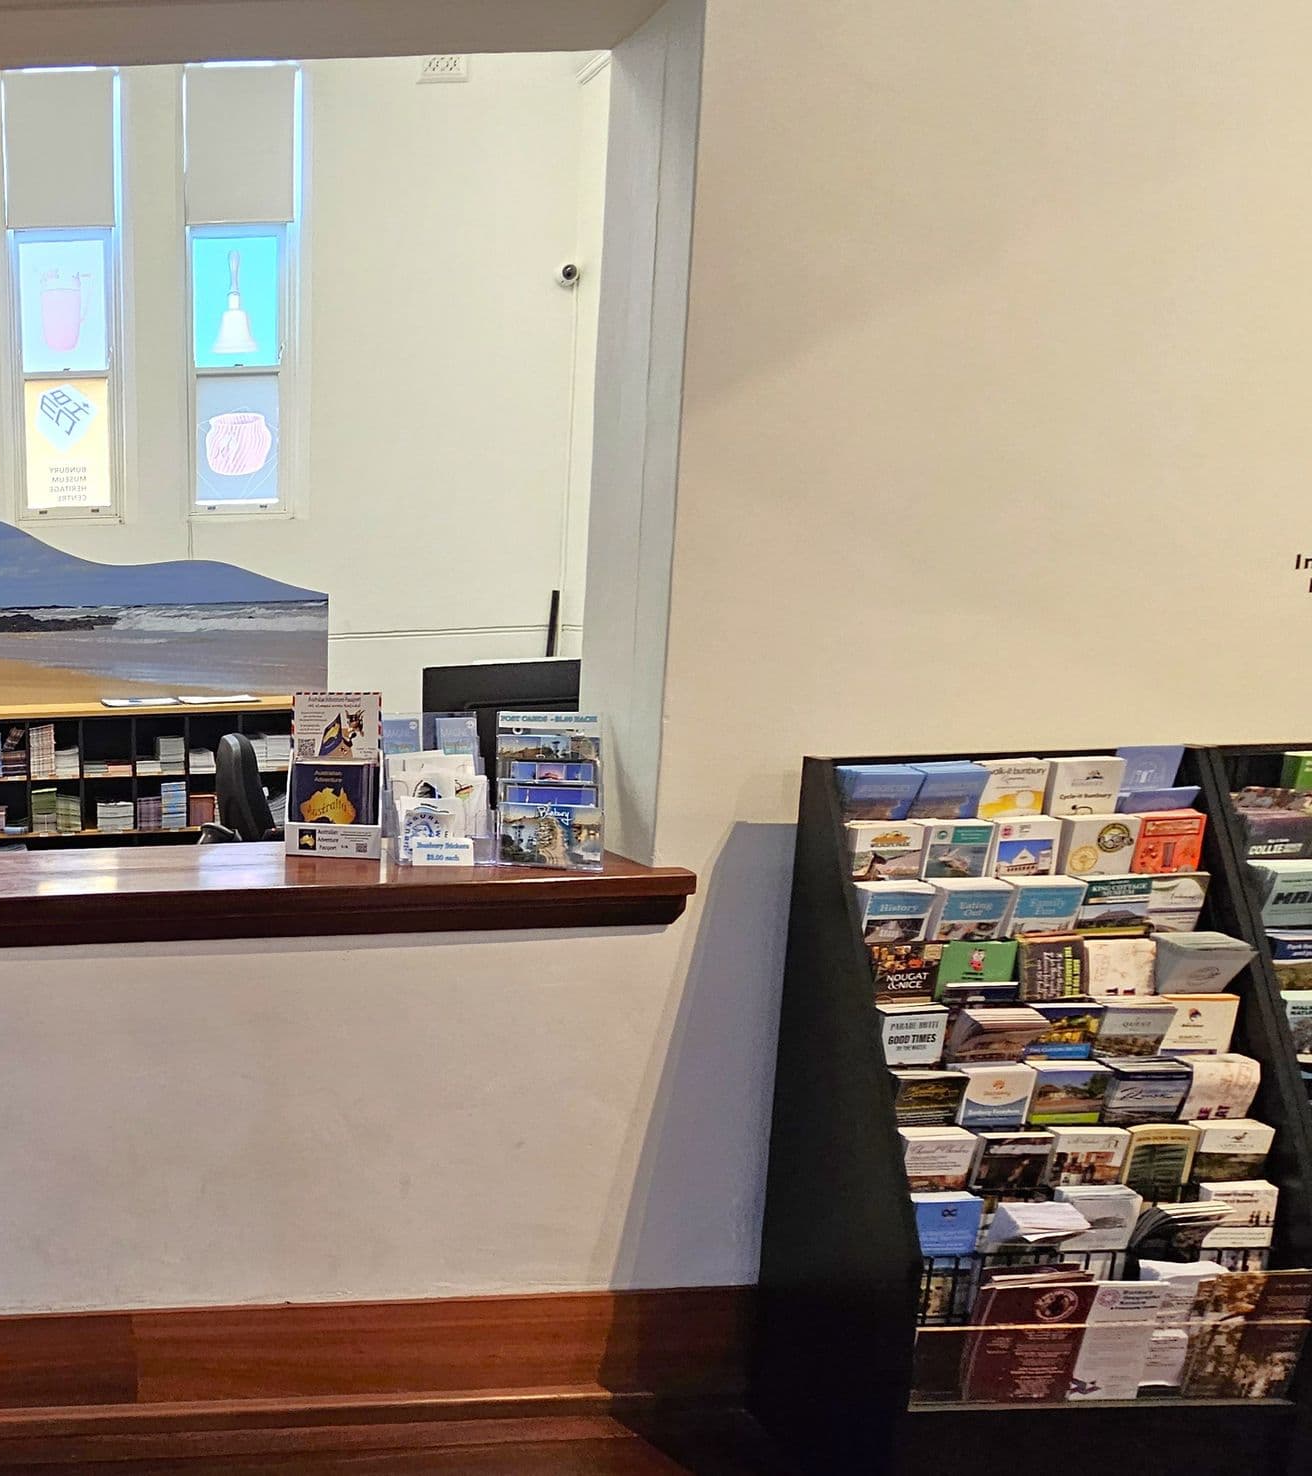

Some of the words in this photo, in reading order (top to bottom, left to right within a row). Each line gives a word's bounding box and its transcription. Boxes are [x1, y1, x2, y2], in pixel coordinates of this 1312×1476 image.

[879, 903, 918, 912] History
[959, 901, 994, 911] Eating
[886, 973, 928, 981] NOUGAT
[888, 1035, 910, 1045] GOOD
[911, 1033, 937, 1043] TIMES
